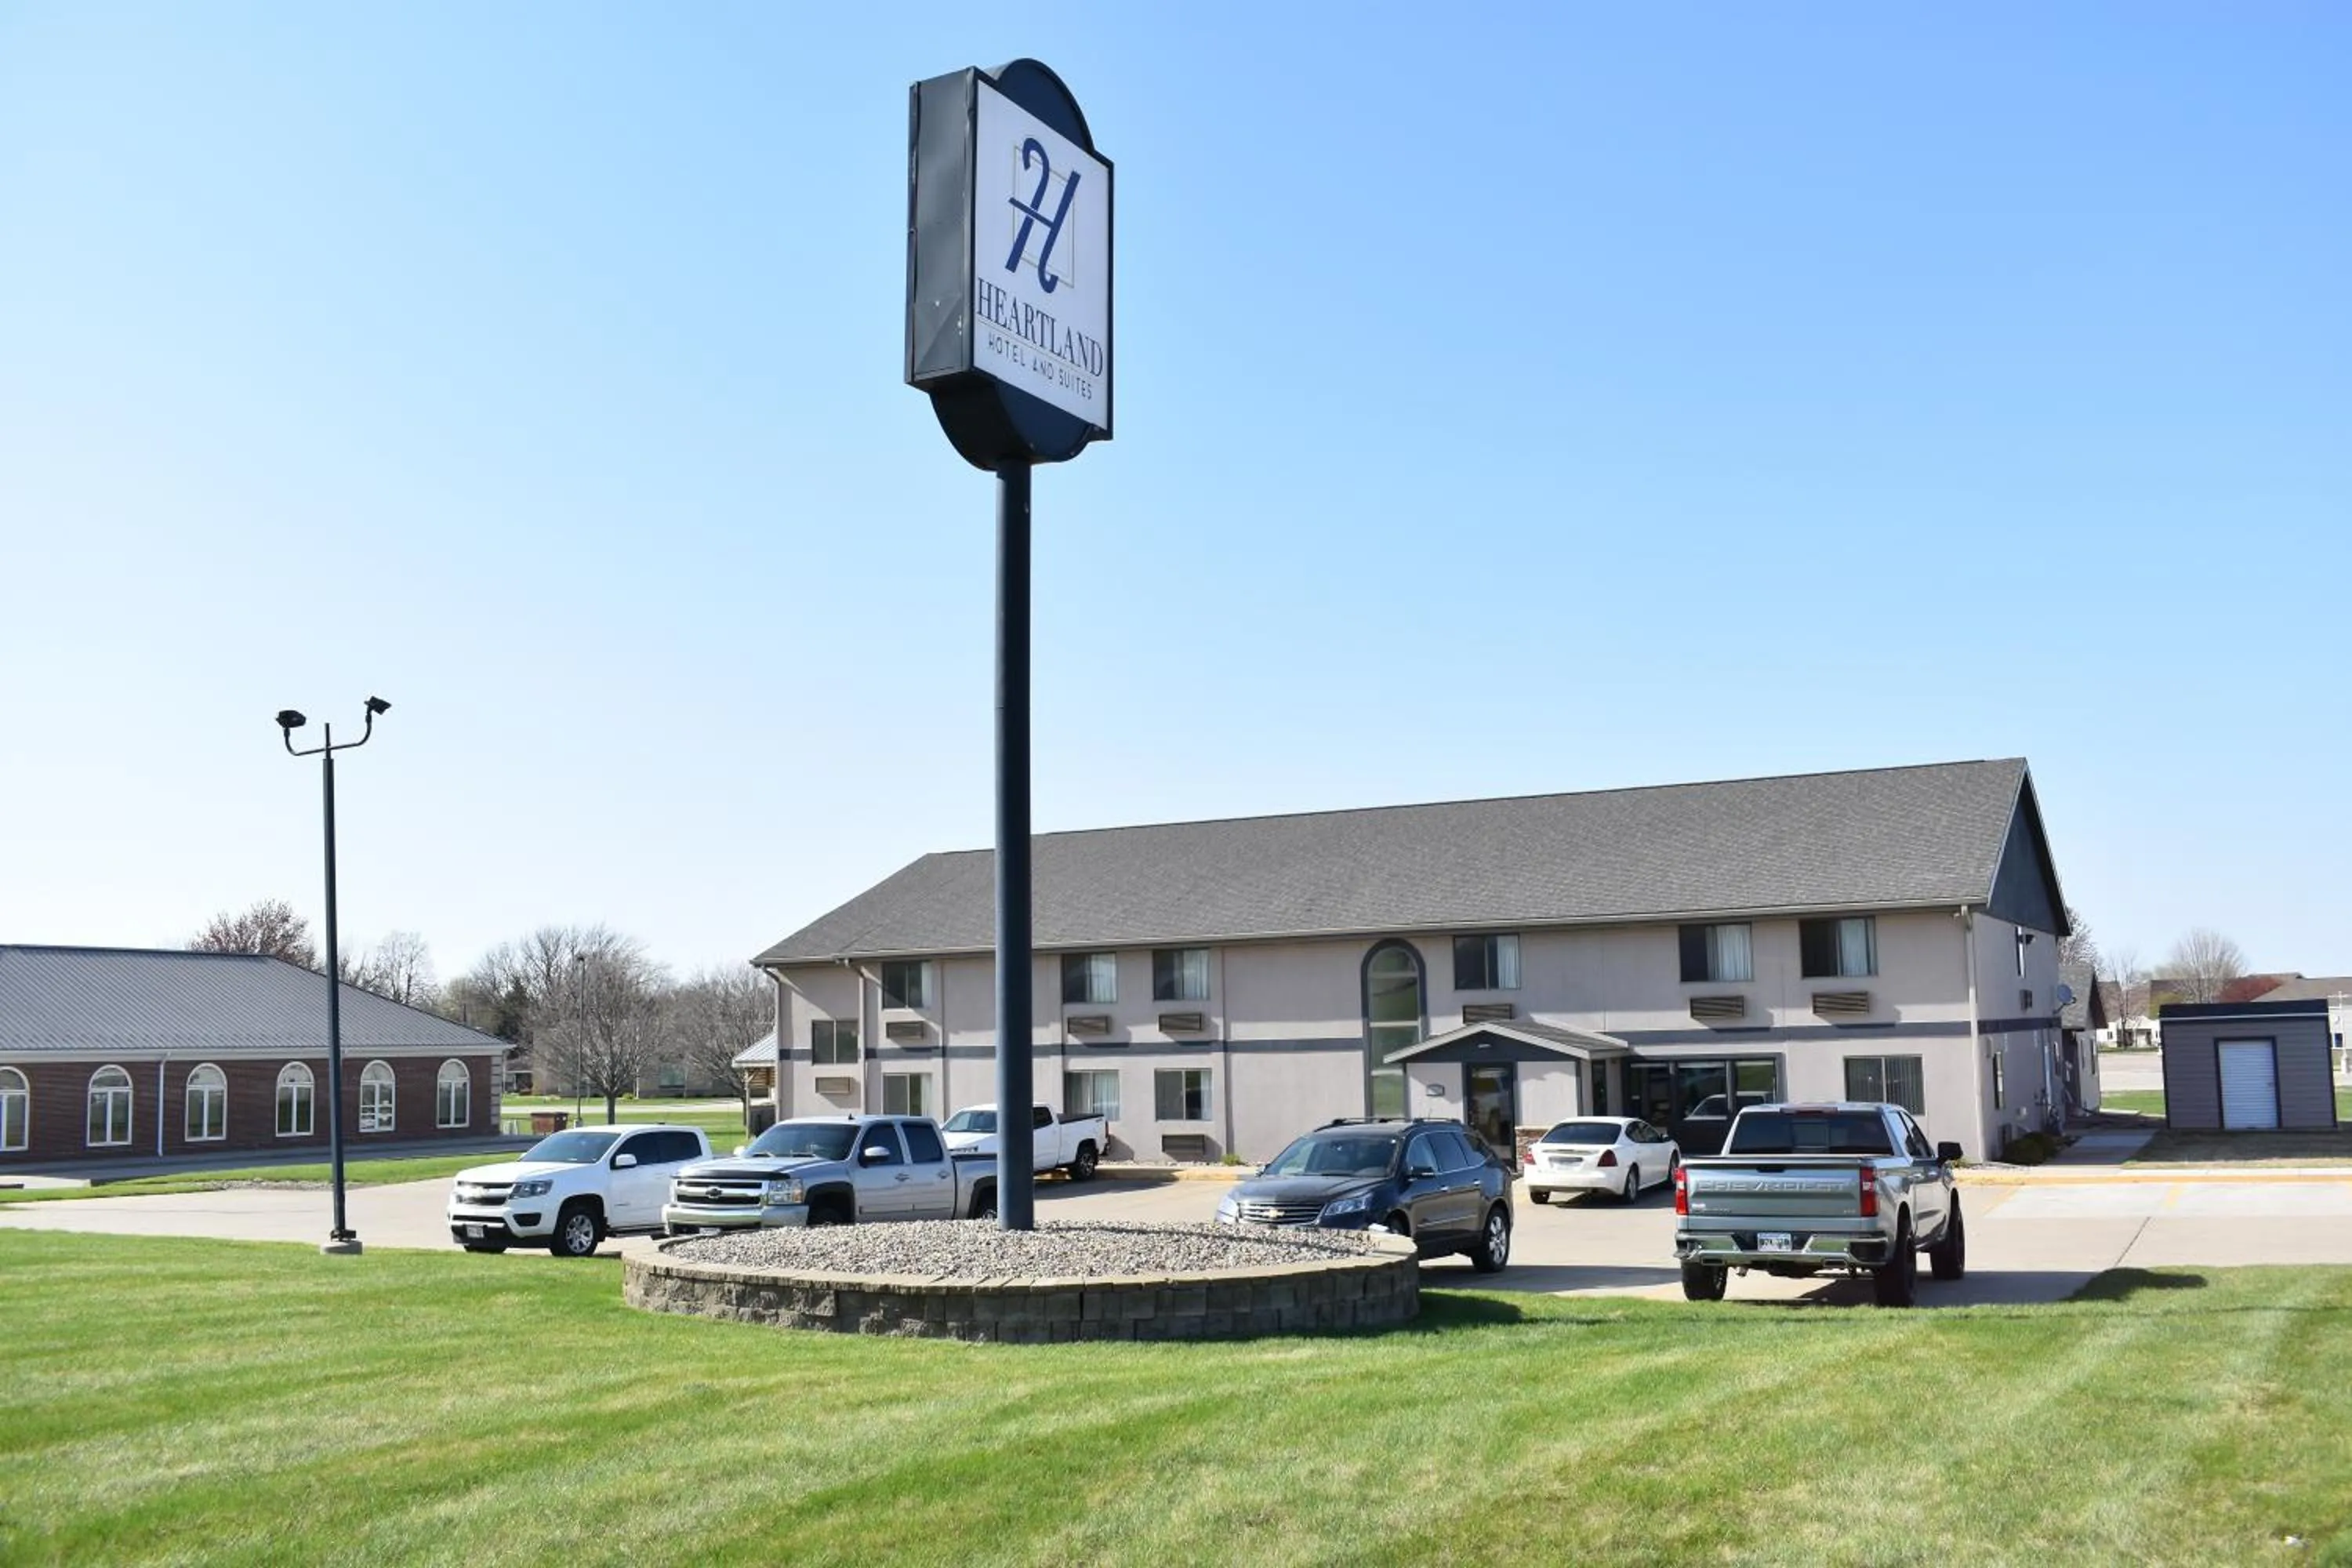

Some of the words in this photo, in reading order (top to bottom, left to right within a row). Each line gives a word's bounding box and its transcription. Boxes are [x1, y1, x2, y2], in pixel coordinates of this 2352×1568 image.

[977, 277, 1104, 377] HEARTLAND
[988, 332, 1025, 367] HOTEL
[1033, 356, 1054, 380] AND
[1059, 368, 1092, 401] SUITES
[1697, 1179, 1846, 1192] CHEVROLET
